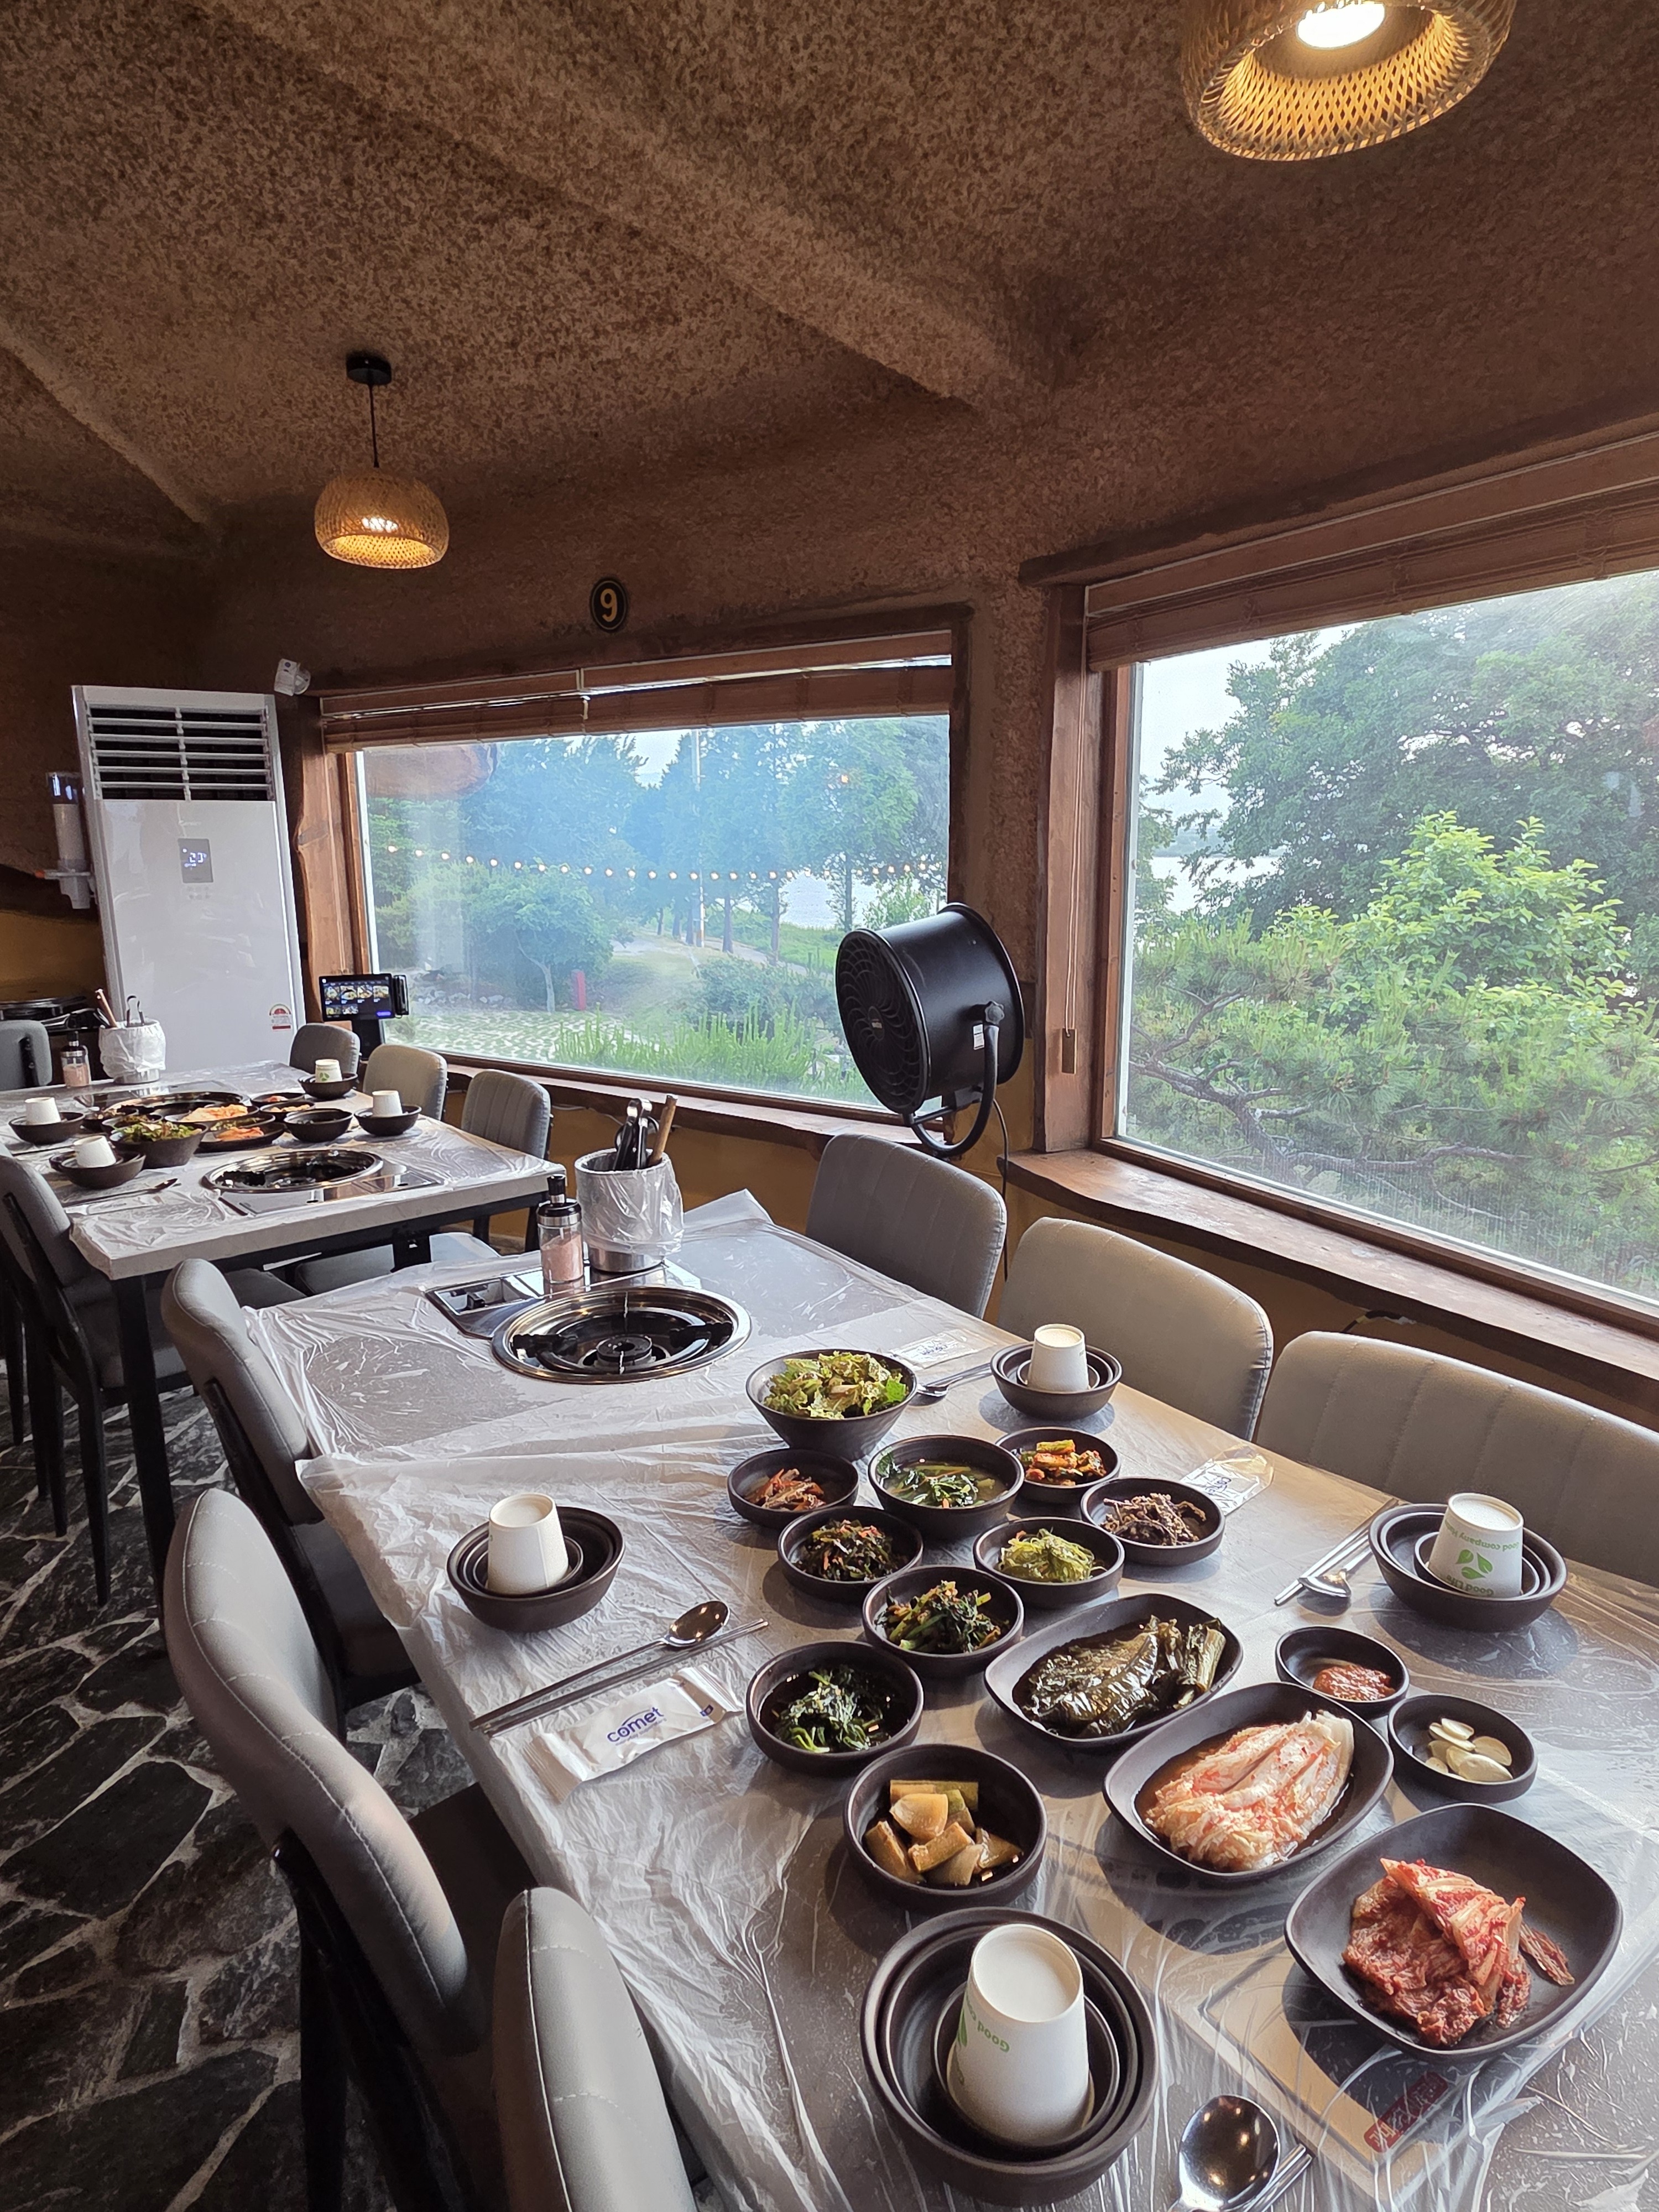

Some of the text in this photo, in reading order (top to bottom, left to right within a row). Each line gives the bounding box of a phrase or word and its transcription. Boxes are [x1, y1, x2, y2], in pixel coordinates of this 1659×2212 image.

[600, 588, 618, 623] 9
[1459, 1532, 1501, 1550] company
[1465, 1582, 1495, 1597] Good
[607, 1707, 665, 1743] comet
[977, 2020, 1010, 2053] Good
